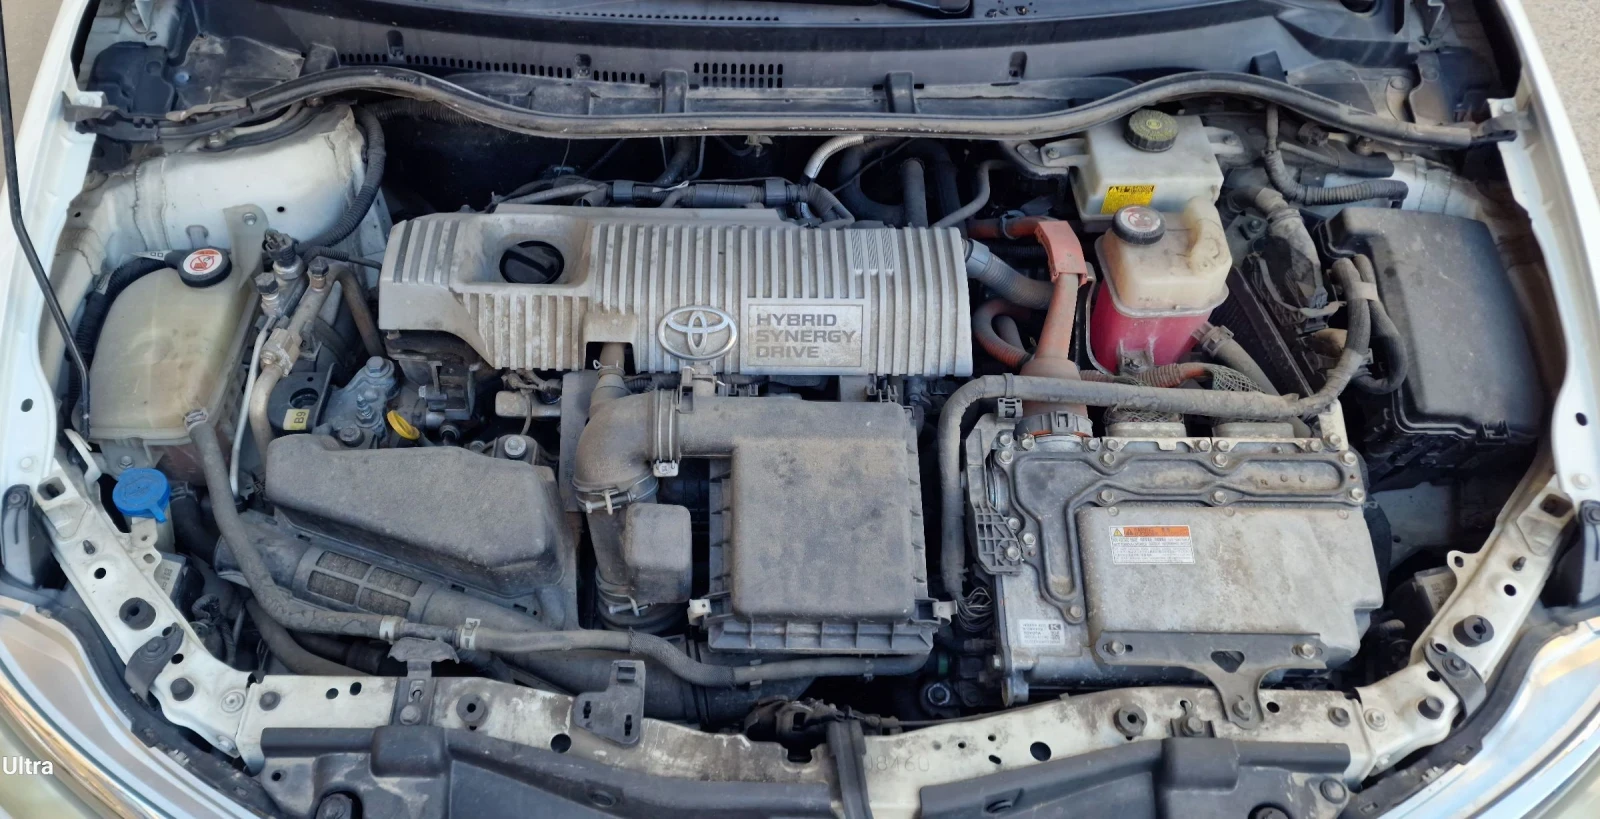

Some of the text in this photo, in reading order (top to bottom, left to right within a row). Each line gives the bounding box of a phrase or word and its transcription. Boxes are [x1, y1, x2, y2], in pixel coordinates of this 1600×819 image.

[757, 313, 837, 326] HYBRID
[756, 330, 856, 343] SYNERGY
[756, 346, 819, 358] DRIVE
[294, 412, 306, 424] B9
